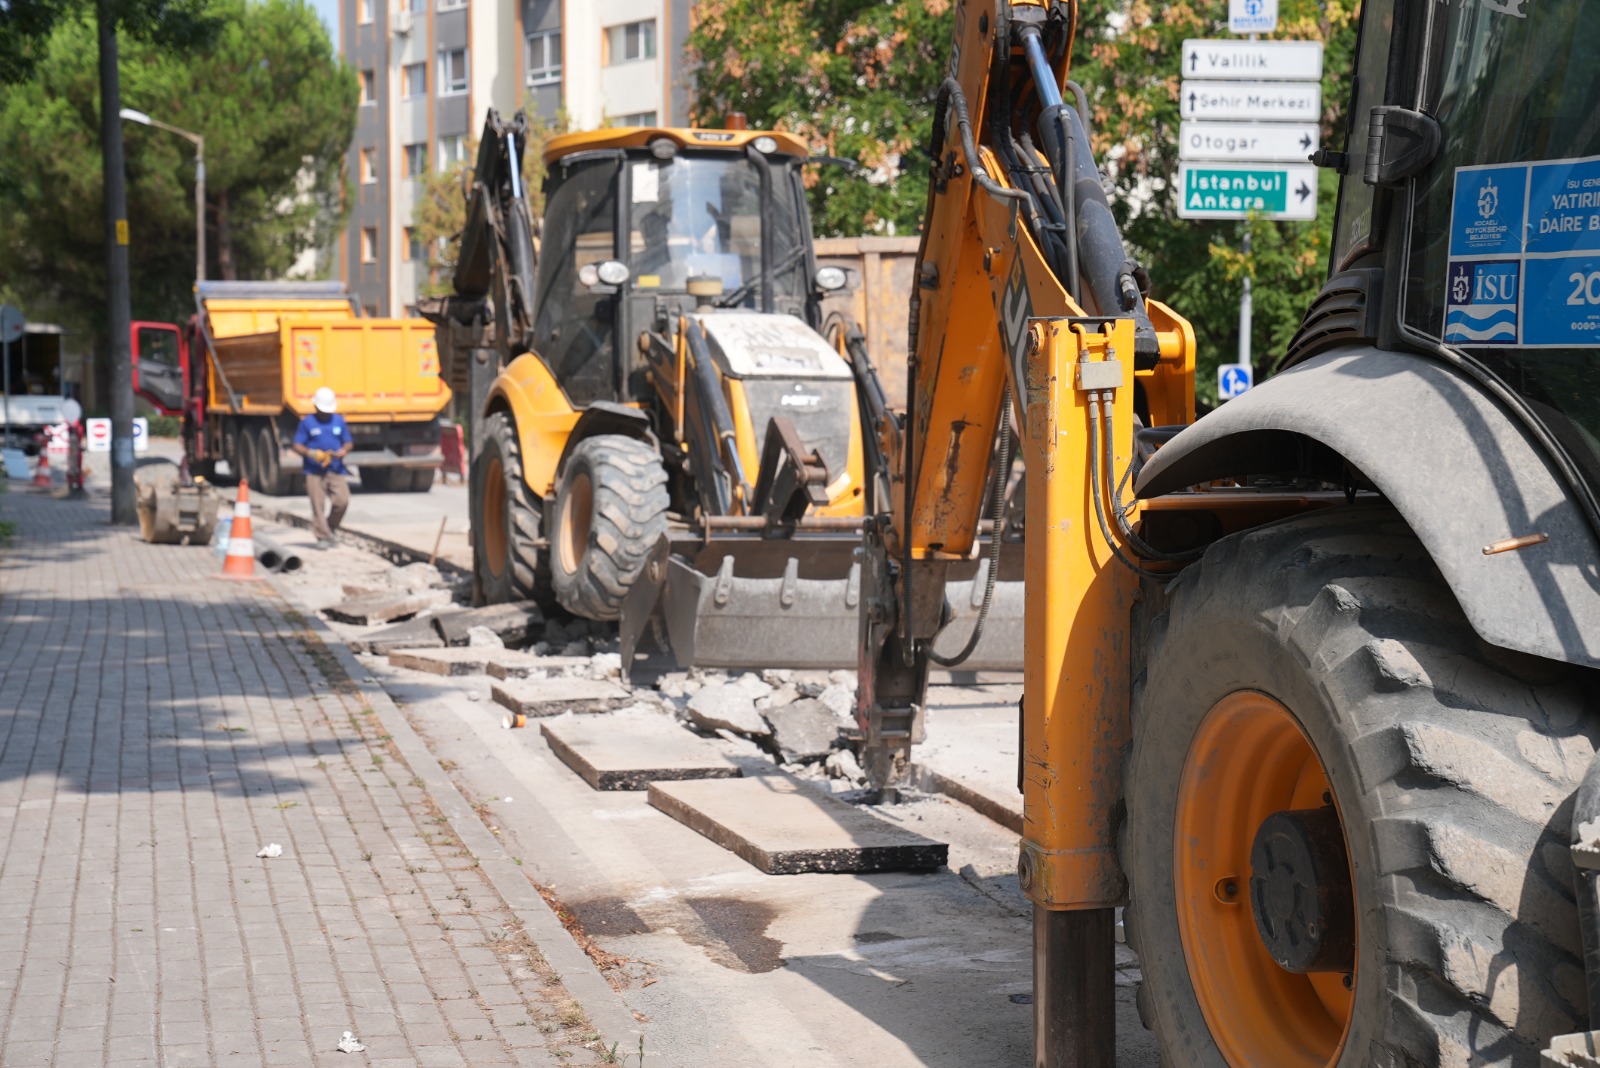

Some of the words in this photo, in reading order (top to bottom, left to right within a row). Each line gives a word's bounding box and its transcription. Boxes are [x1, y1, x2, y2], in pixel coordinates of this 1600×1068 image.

[1208, 53, 1268, 68] Valilik
[1247, 95, 1311, 109] Merkezi
[1190, 133, 1258, 153] Otogar
[1189, 192, 1265, 209] Ankara
[1539, 213, 1584, 234] DAİRE
[1475, 268, 1517, 300] İSU
